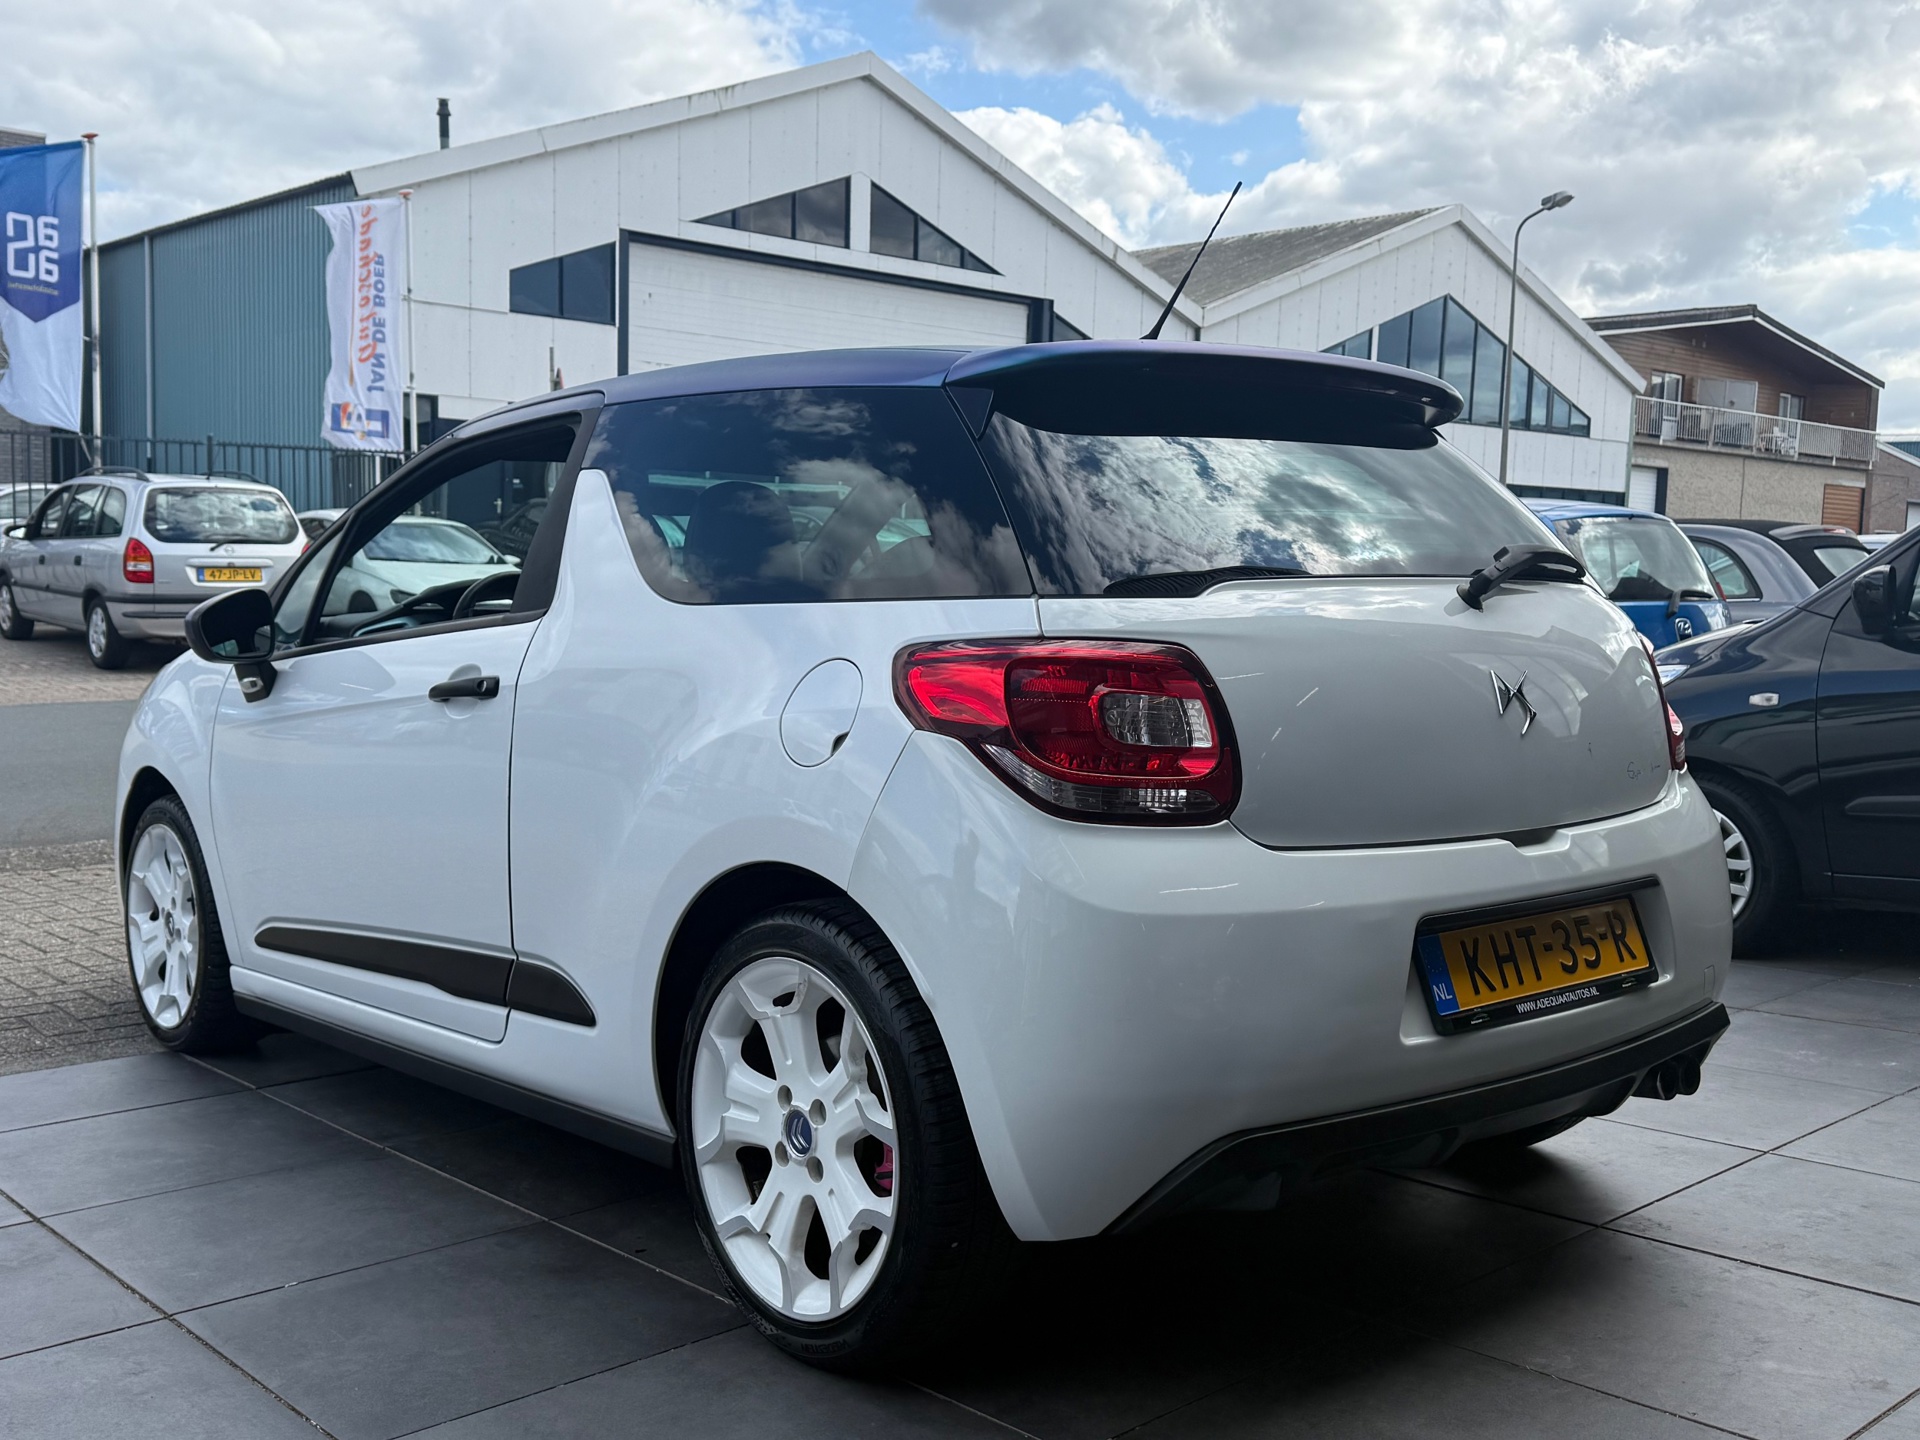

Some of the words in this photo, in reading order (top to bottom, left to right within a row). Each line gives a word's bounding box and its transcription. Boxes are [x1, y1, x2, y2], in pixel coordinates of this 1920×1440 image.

[1459, 910, 1638, 996] KHT-35-R
[1433, 985, 1453, 1002] NL
[1516, 986, 1600, 1014] WWW.ADEQUAATAUTOS.NL
